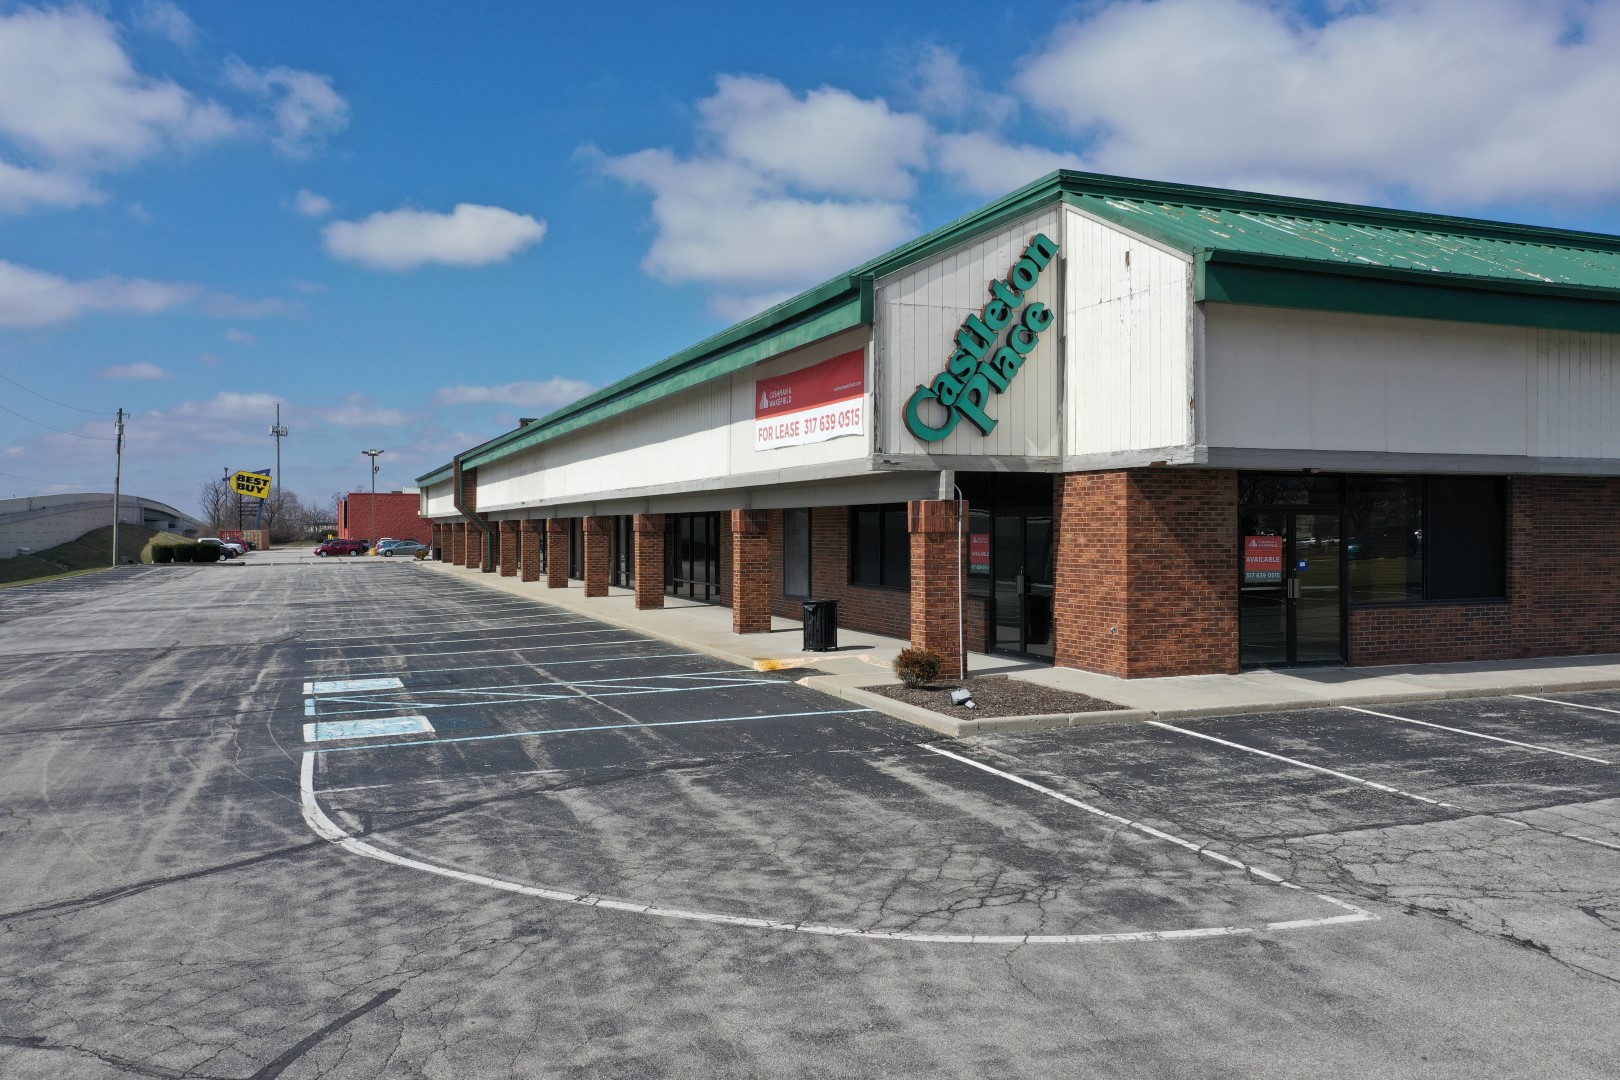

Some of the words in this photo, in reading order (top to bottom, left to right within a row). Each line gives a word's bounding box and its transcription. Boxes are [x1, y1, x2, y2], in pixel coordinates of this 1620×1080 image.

[902, 233, 1059, 442] Castleton
[954, 302, 1054, 436] Place
[769, 387, 788, 399] CUSHMAN
[769, 397, 792, 408] WAKEFIELD
[758, 426, 773, 442] FOR
[775, 420, 800, 440] LEASE
[804, 417, 818, 435] 317
[819, 413, 836, 432] 639
[838, 407, 860, 428] 0515
[237, 474, 269, 486] BEST
[237, 482, 265, 494] BUY
